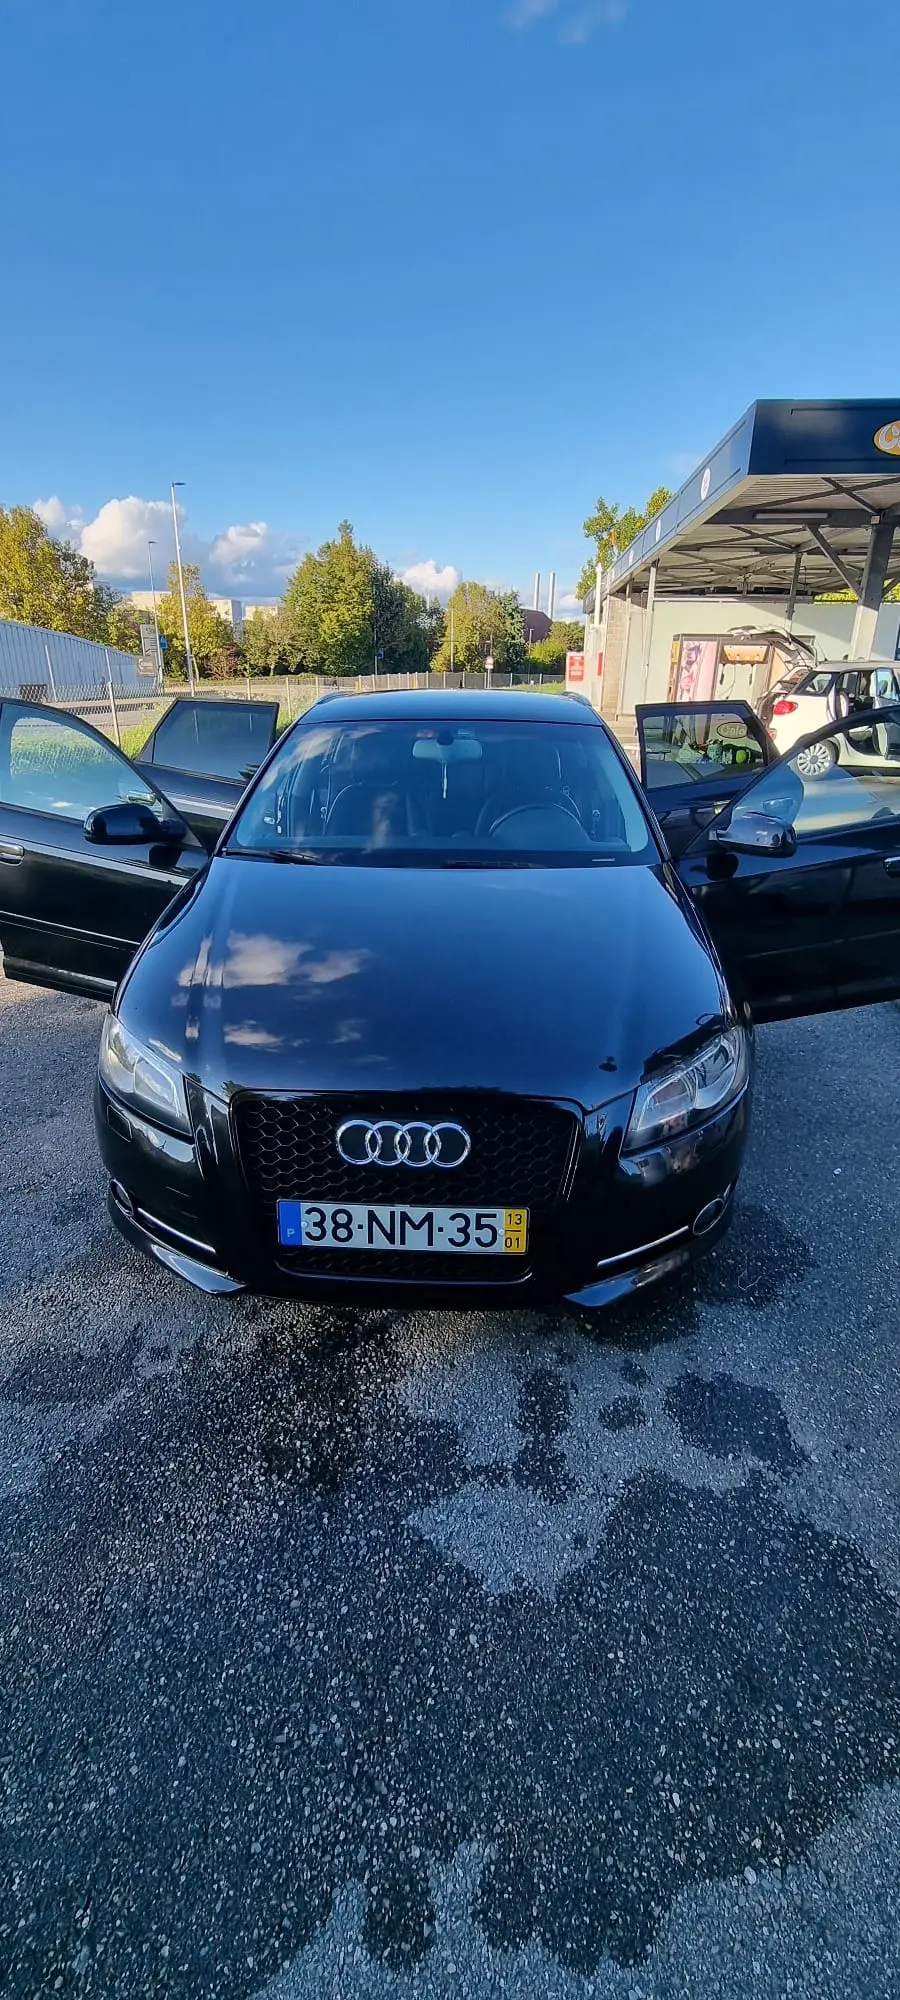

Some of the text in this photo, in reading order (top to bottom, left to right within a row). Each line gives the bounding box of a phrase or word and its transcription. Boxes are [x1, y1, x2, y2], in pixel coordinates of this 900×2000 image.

[506, 1213, 523, 1226] 13
[286, 1228, 295, 1238] P
[504, 1236, 521, 1249] 01
